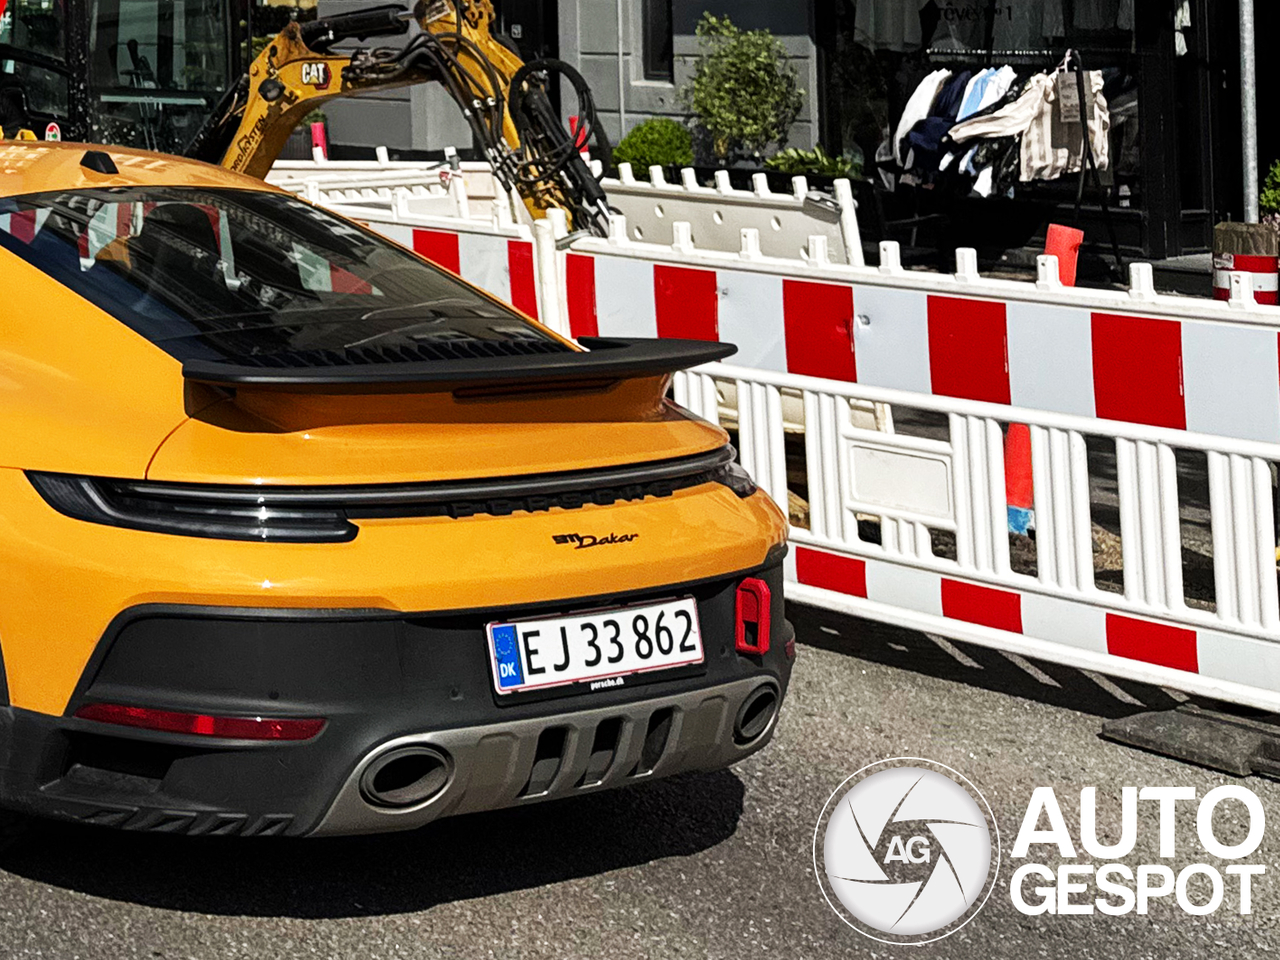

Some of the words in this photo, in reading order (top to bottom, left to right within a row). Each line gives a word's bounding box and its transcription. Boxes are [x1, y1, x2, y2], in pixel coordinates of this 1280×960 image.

[302, 62, 325, 84] CAT
[450, 483, 674, 519] PORSCHE
[574, 532, 639, 549] Dakar
[580, 619, 624, 667] 33
[632, 609, 696, 660] 862
[500, 663, 517, 678] DK
[590, 677, 625, 691] porsche.dk
